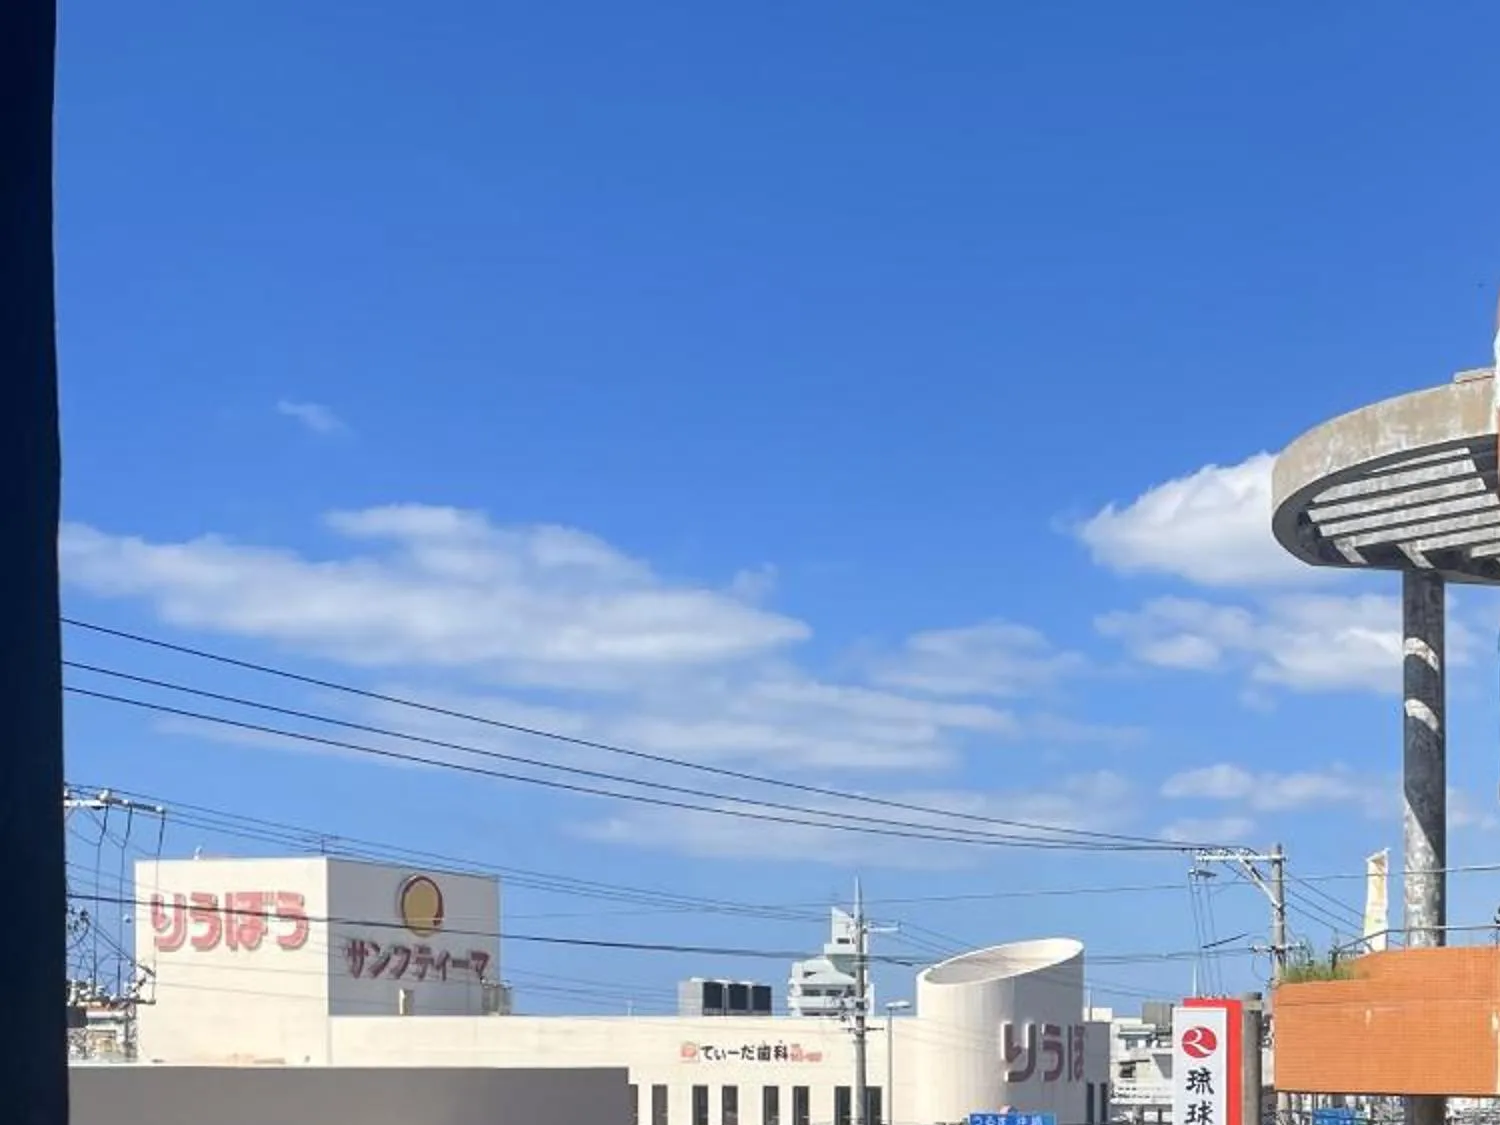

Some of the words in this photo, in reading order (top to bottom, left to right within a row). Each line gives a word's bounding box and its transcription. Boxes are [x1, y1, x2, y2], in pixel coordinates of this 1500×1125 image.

[150, 891, 310, 952] りうぼう
[700, 1041, 789, 1062] てぃーだ歯科
